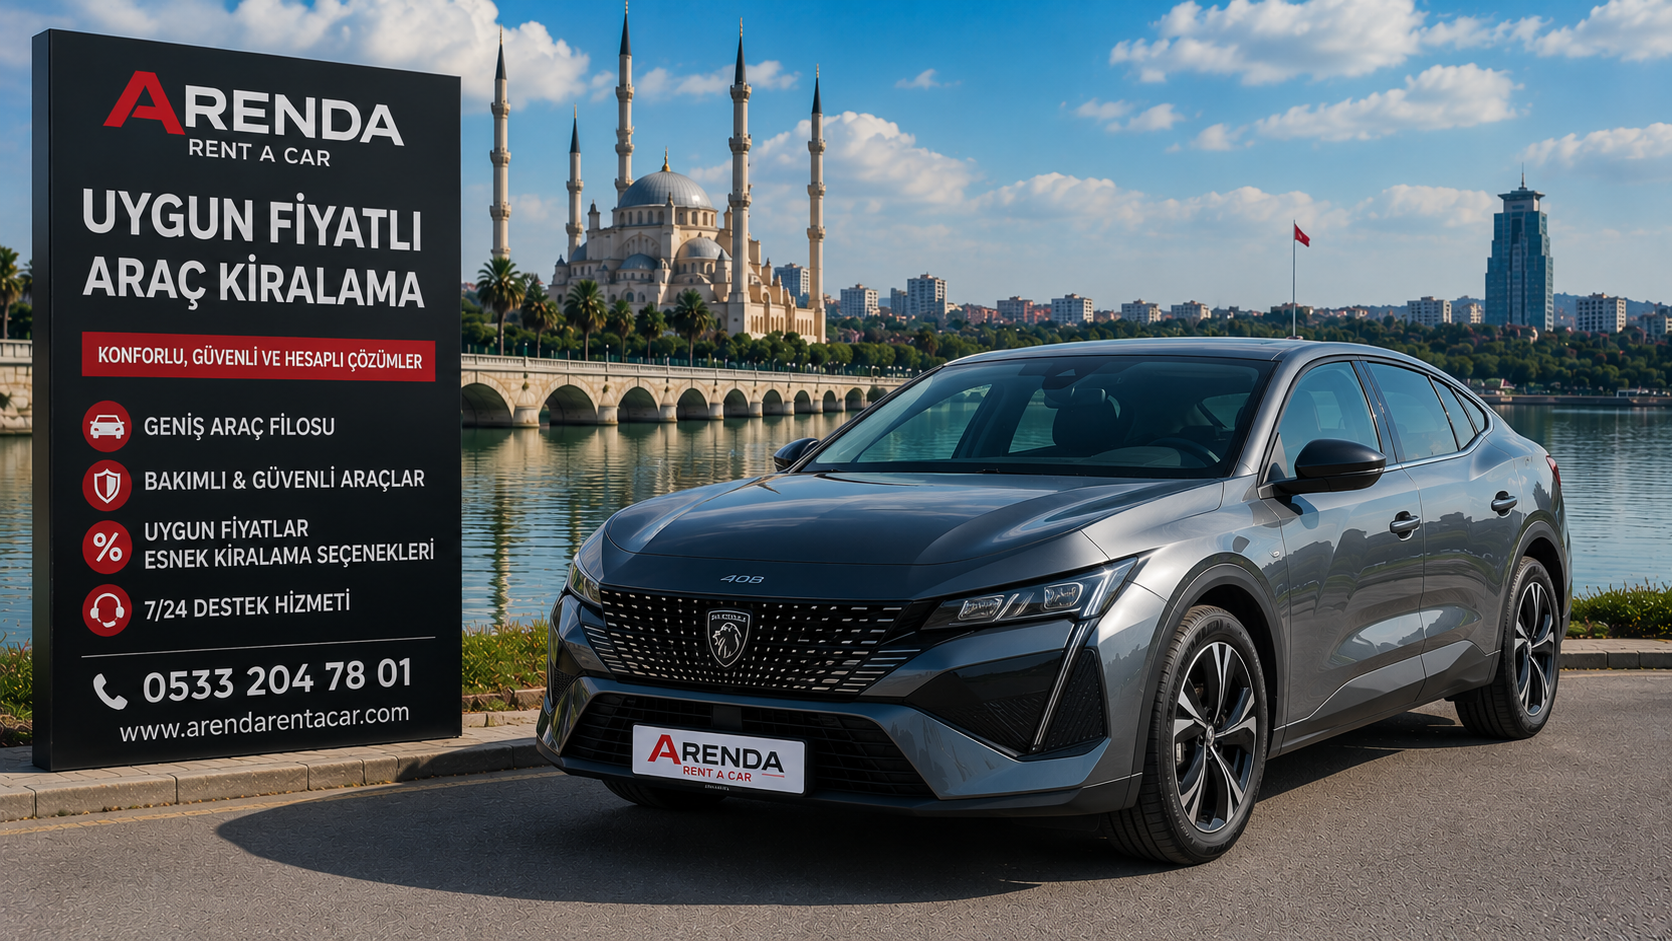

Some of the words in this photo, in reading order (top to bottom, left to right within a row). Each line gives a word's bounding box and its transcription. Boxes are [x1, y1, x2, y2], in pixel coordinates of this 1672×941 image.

[103, 70, 405, 147] ARENDA
[188, 138, 253, 161] RENT
[259, 145, 276, 163] A
[284, 147, 331, 167] CAR
[82, 187, 254, 242] UYGUN
[269, 192, 422, 252] FİYATLI
[82, 255, 207, 311] ARAÇ
[219, 253, 426, 309] KİRALAMA
[98, 346, 188, 367] KONFORLU,
[192, 344, 258, 367] GÜVENLİ
[261, 349, 281, 367] VE
[285, 350, 344, 369] HESAPLI
[347, 348, 423, 373] ÇÖZÜMLER
[144, 412, 205, 441] GENİŞ
[209, 417, 264, 441] ARAÇ
[269, 412, 335, 436] FİLOSU
[144, 471, 227, 491] BAKIMLI
[232, 470, 247, 490] &
[252, 465, 335, 490] GÜVENLİ
[340, 469, 425, 493] ARAÇLAR
[144, 520, 215, 542] UYGUN
[221, 515, 309, 539] FİYATLAR
[144, 549, 209, 570] ESNEK
[214, 543, 313, 568] KİRALAMA
[316, 537, 435, 568] SEÇENEKLERİ
[144, 598, 188, 622] 7/24
[193, 595, 270, 618] DESTEK
[275, 587, 350, 614] HİZMETİ
[143, 667, 234, 703] 0533
[246, 661, 314, 697] 204
[325, 660, 366, 692] 78
[377, 657, 411, 688] 01
[119, 705, 410, 742] www.arendarentacar.com
[647, 733, 785, 774] ARENDA
[682, 765, 714, 778] RENT
[716, 770, 726, 780] A
[727, 770, 752, 783] CAR
